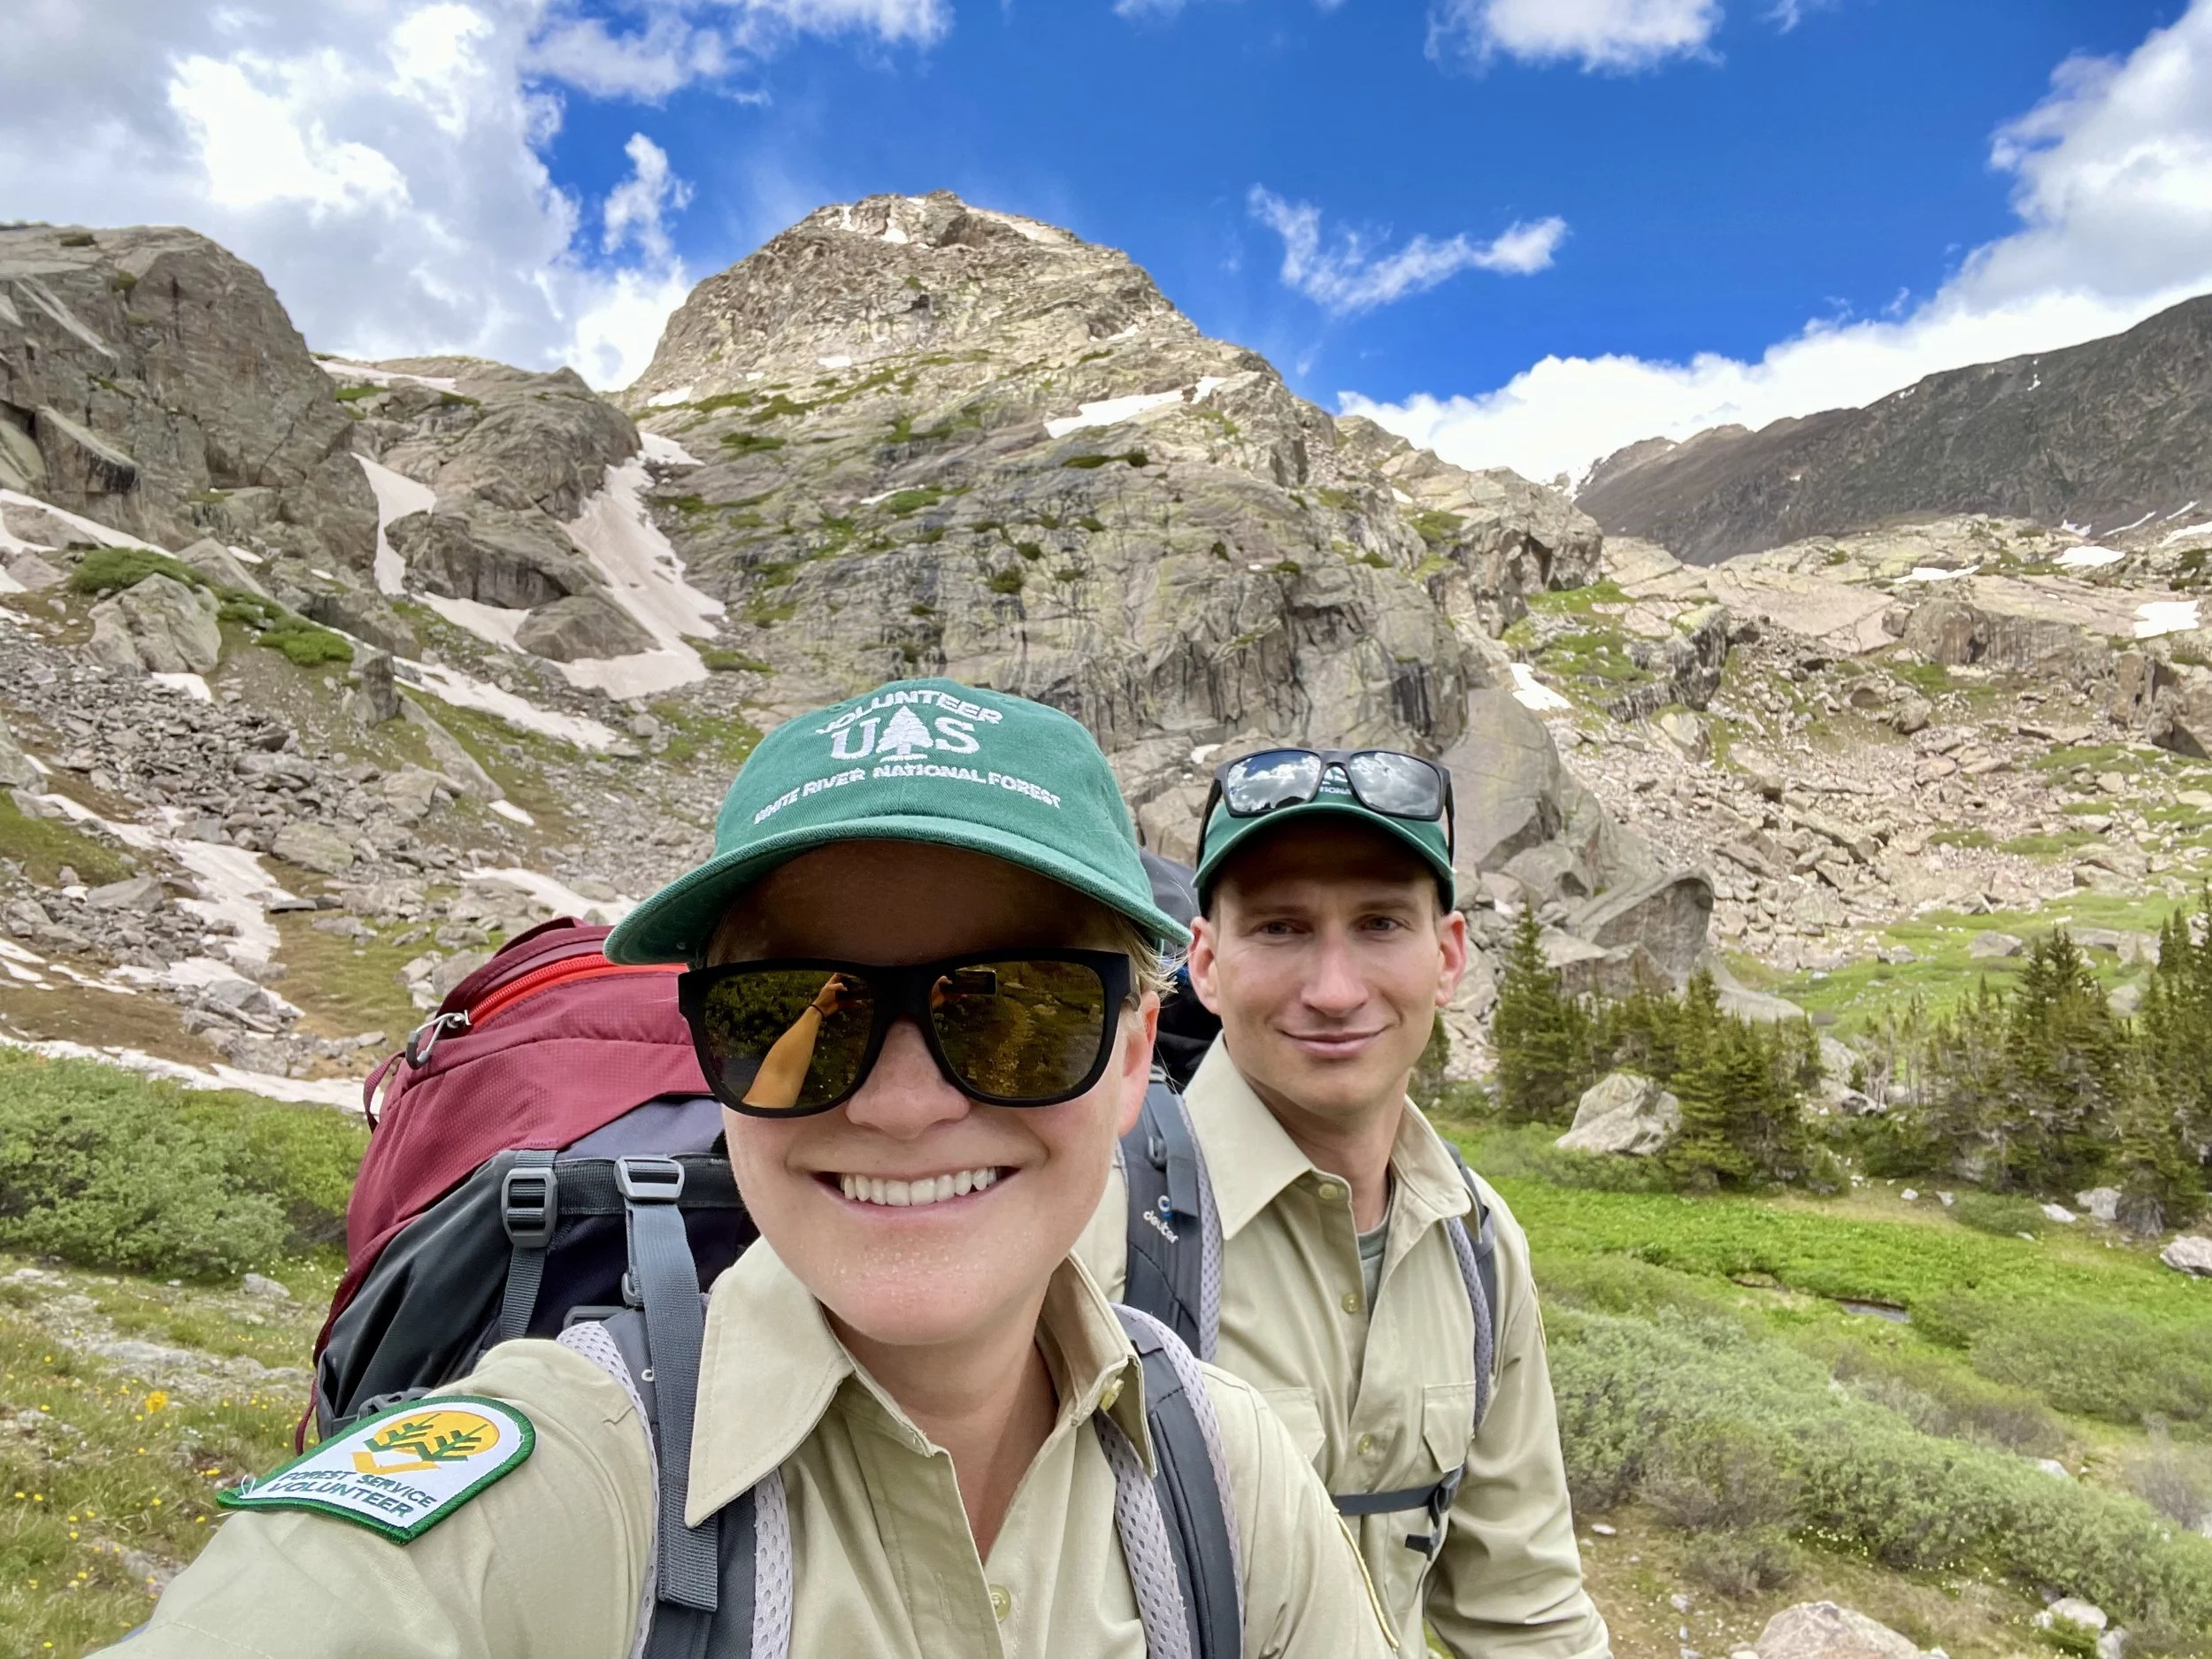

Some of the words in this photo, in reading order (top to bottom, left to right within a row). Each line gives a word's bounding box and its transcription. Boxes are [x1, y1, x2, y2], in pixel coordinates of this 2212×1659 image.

[802, 767, 866, 797] RIVER
[872, 763, 987, 784] NATIONAL
[987, 771, 1061, 810] FOREST
[1142, 1210, 1179, 1244] deuter
[268, 1481, 414, 1518] VOLUNTEER
[280, 1470, 357, 1481] FOREST
[357, 1474, 437, 1509] SERVICE
